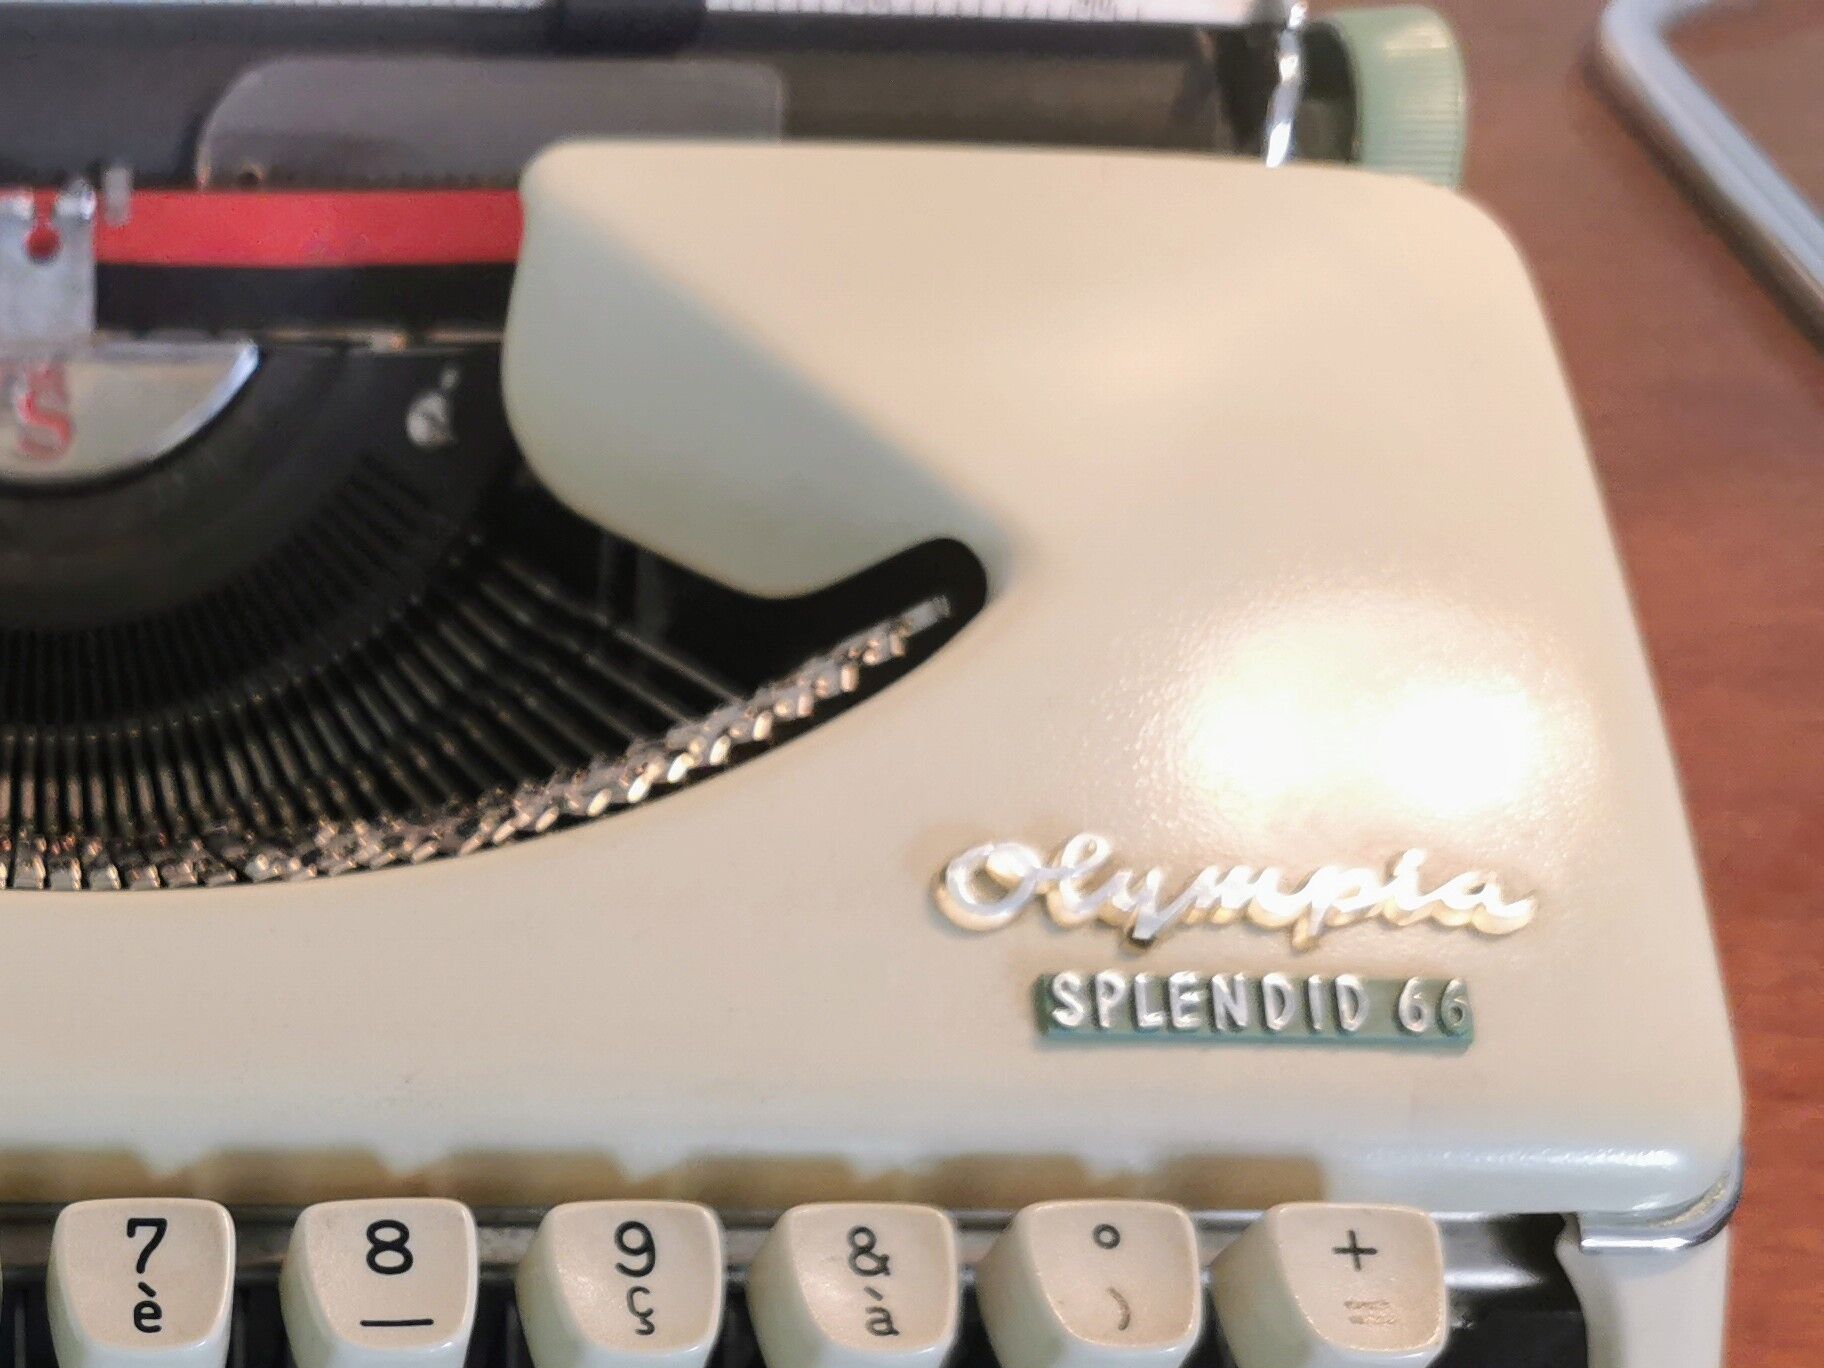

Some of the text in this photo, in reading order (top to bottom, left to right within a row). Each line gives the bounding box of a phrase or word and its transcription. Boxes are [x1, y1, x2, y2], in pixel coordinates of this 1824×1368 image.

[937, 832, 1538, 952] Olympia
[1049, 970, 1474, 1033] SPLENDID 66
[127, 1218, 167, 1274] 7
[366, 1220, 413, 1275] 8
[615, 1221, 656, 1278] 9
[848, 1226, 890, 1276] &
[1334, 1230, 1377, 1270] +
[133, 1282, 162, 1333] è
[627, 1286, 655, 1335] ç
[866, 1287, 899, 1336] à
[1109, 1288, 1131, 1331] )
